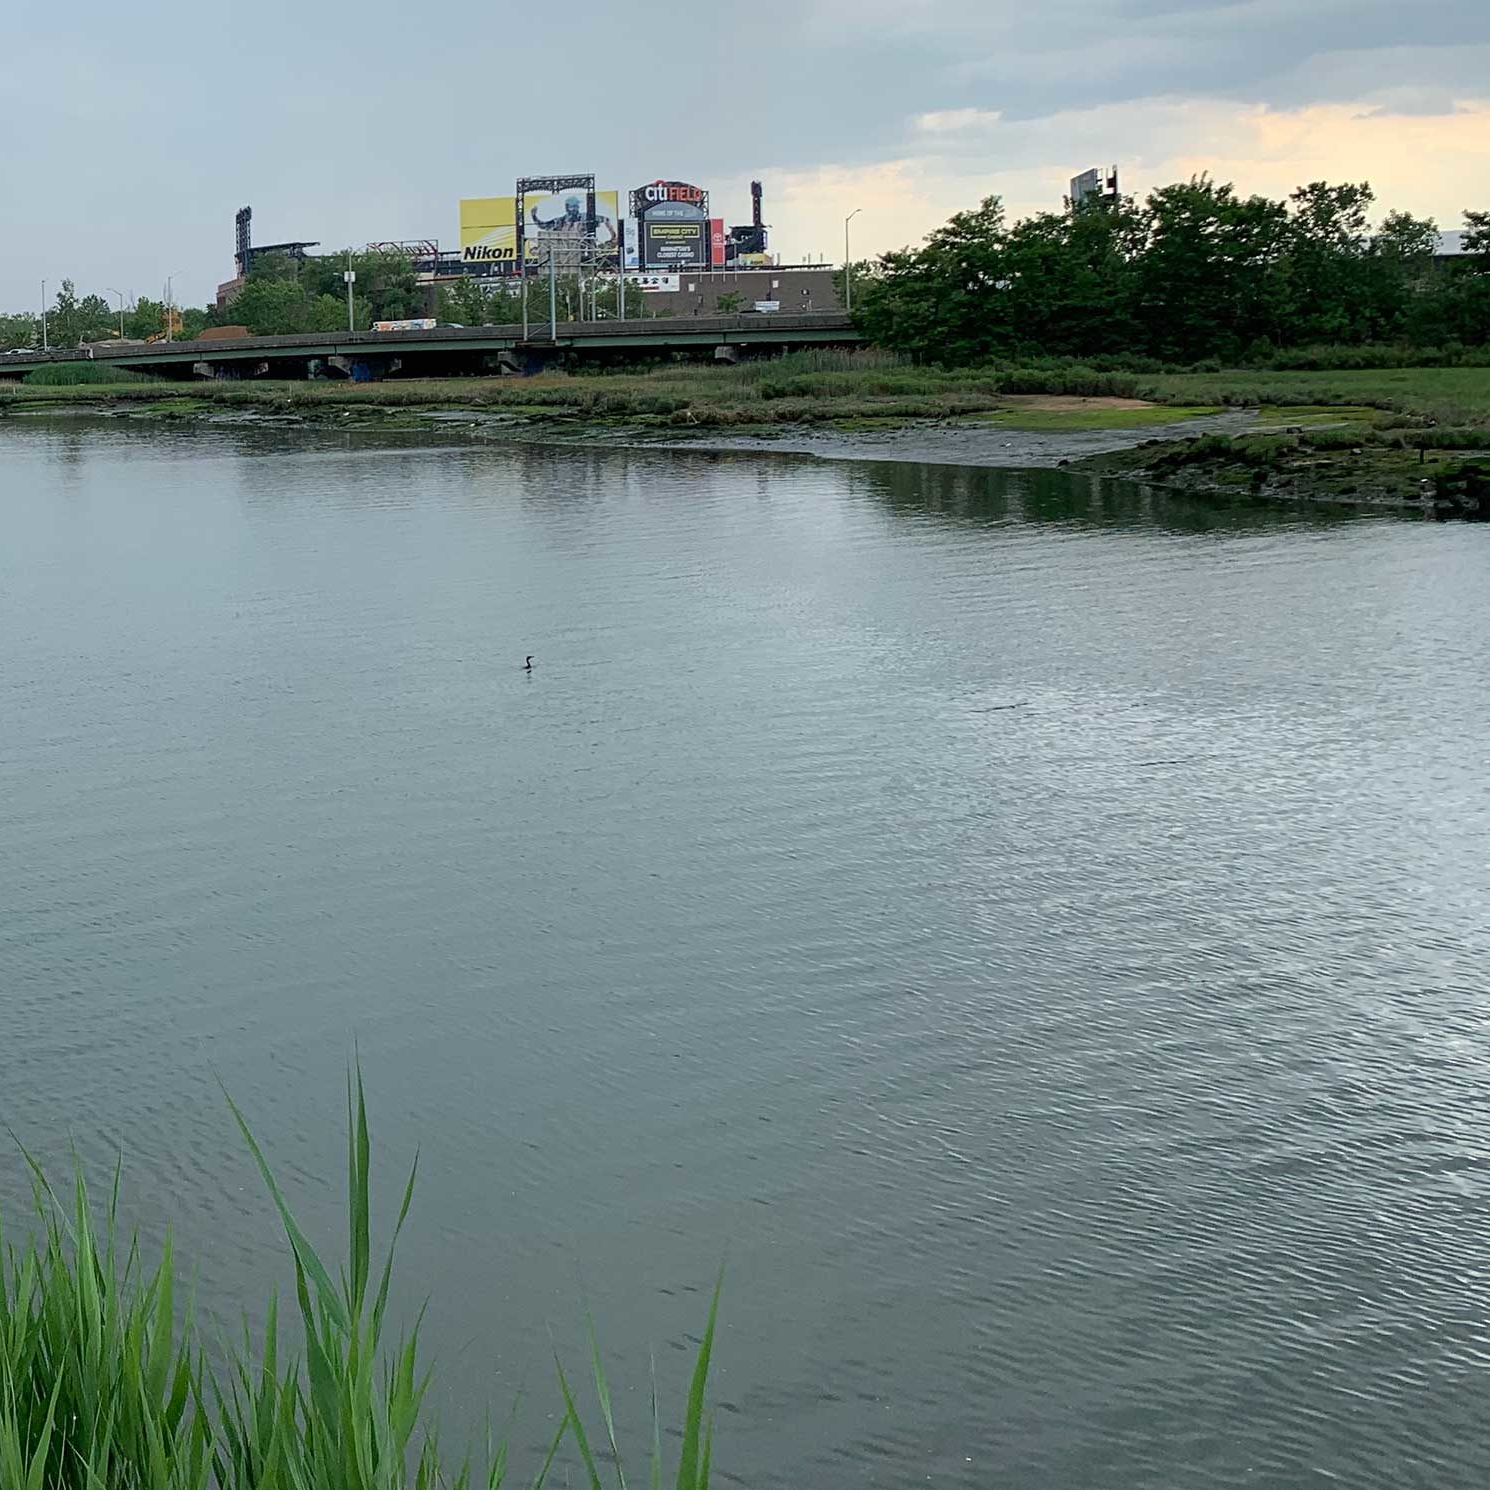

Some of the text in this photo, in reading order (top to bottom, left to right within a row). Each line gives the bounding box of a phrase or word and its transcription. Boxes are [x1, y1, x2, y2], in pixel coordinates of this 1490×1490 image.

[646, 184, 702, 201] citi FIELD
[464, 246, 514, 260] Nikon
